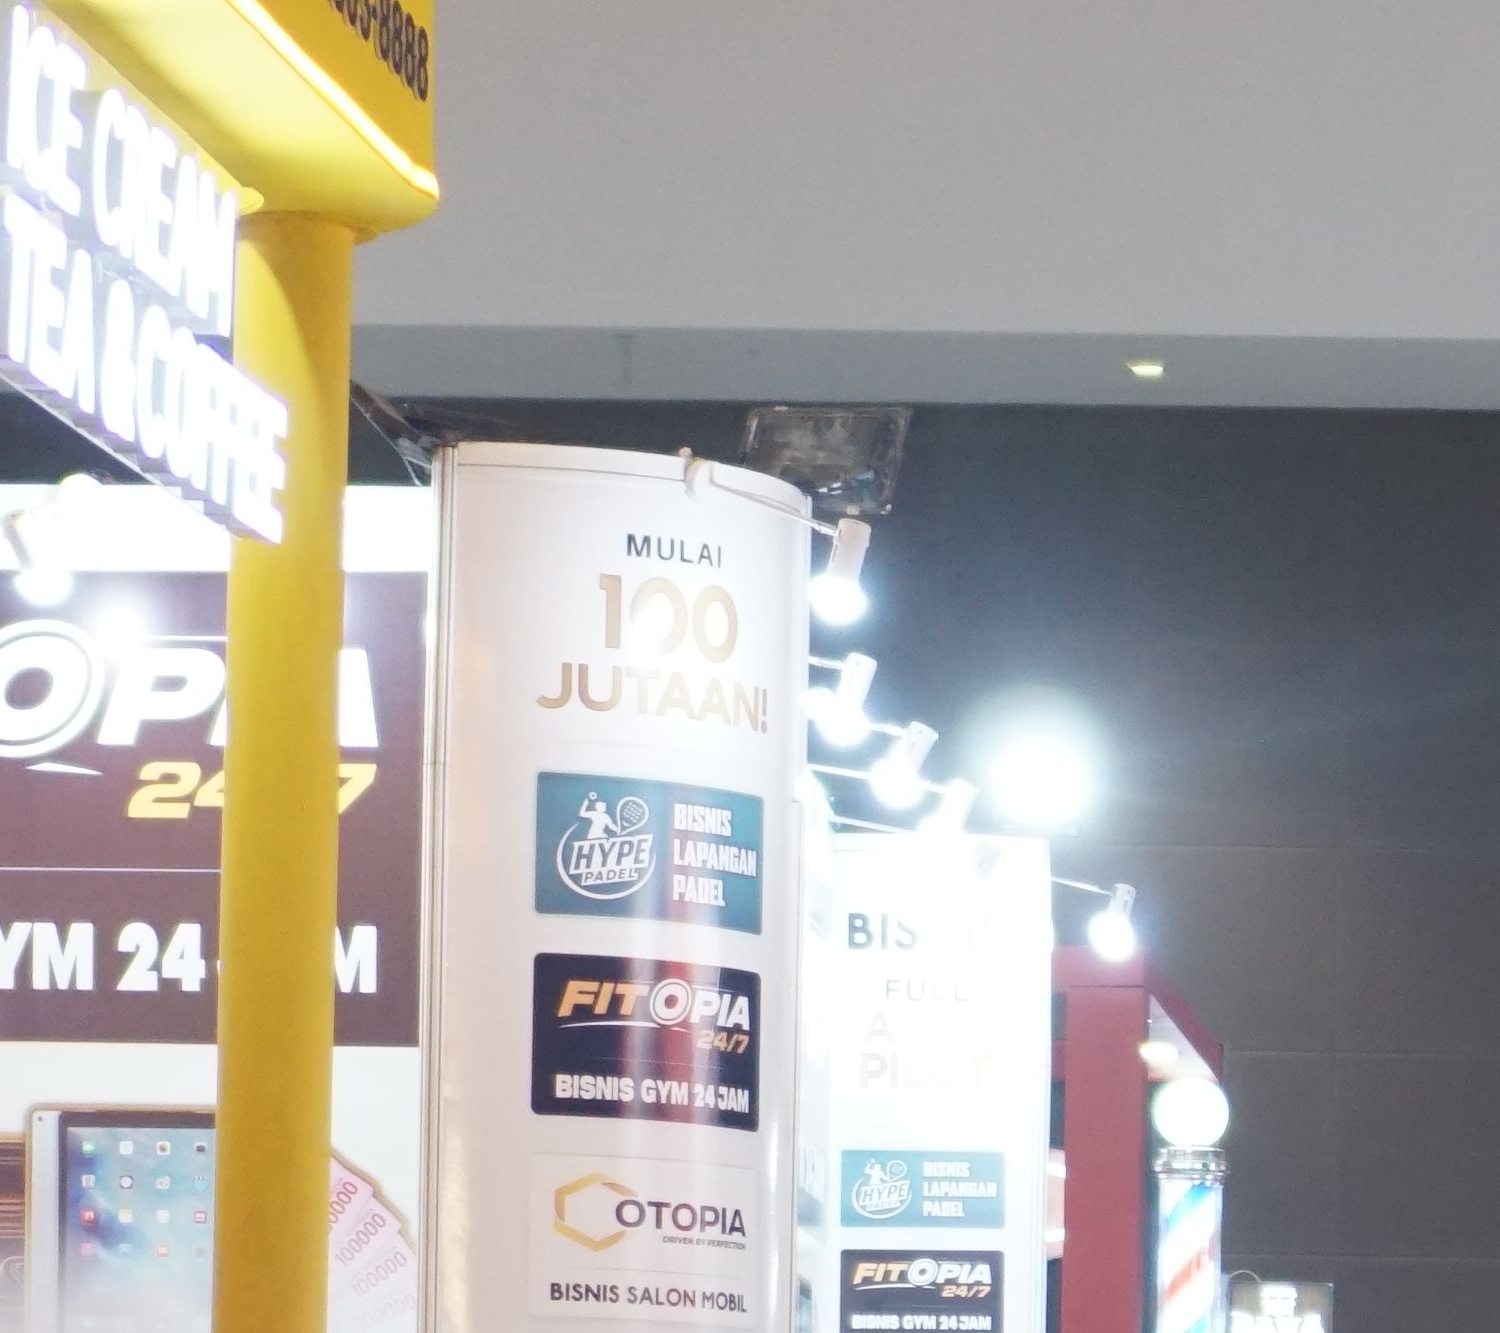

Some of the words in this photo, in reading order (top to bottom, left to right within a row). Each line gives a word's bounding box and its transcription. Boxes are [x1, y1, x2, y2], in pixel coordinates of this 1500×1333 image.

[6, 4, 86, 216] ICE
[94, 88, 238, 337] CREAM
[626, 533, 722, 568] MULAI
[599, 573, 738, 663] 100
[536, 662, 768, 734] JUTAAN!
[674, 803, 731, 837] BISNIS
[574, 837, 649, 871] HYPE
[674, 839, 757, 877] LAPANGAN
[583, 867, 638, 885] PADEL
[673, 875, 726, 906] PADEL
[116, 922, 205, 992] 24
[557, 978, 750, 1031] FITOPIA
[697, 1029, 749, 1054] 24/7
[555, 1074, 634, 1102] BISNIS
[641, 1079, 688, 1105] GYM
[693, 1083, 716, 1108] 24
[717, 1086, 749, 1113] JAM
[923, 1162, 970, 1177] BISNIS
[863, 1181, 910, 1203] HYPE
[923, 1182, 997, 1198] LAPANGAN
[615, 1199, 746, 1237] OTOPIA
[923, 1201, 965, 1217] PADEL
[853, 1258, 992, 1286] FITOPIA
[550, 1283, 619, 1304] BISNIS
[627, 1286, 696, 1308] SALON
[702, 1290, 747, 1313] MOBIL
[941, 1285, 991, 1298] 24/7
[852, 1314, 900, 1330] BISNIS
[902, 1314, 937, 1330] GYM
[939, 1315, 958, 1330] 24
[959, 1315, 992, 1331] JAM
